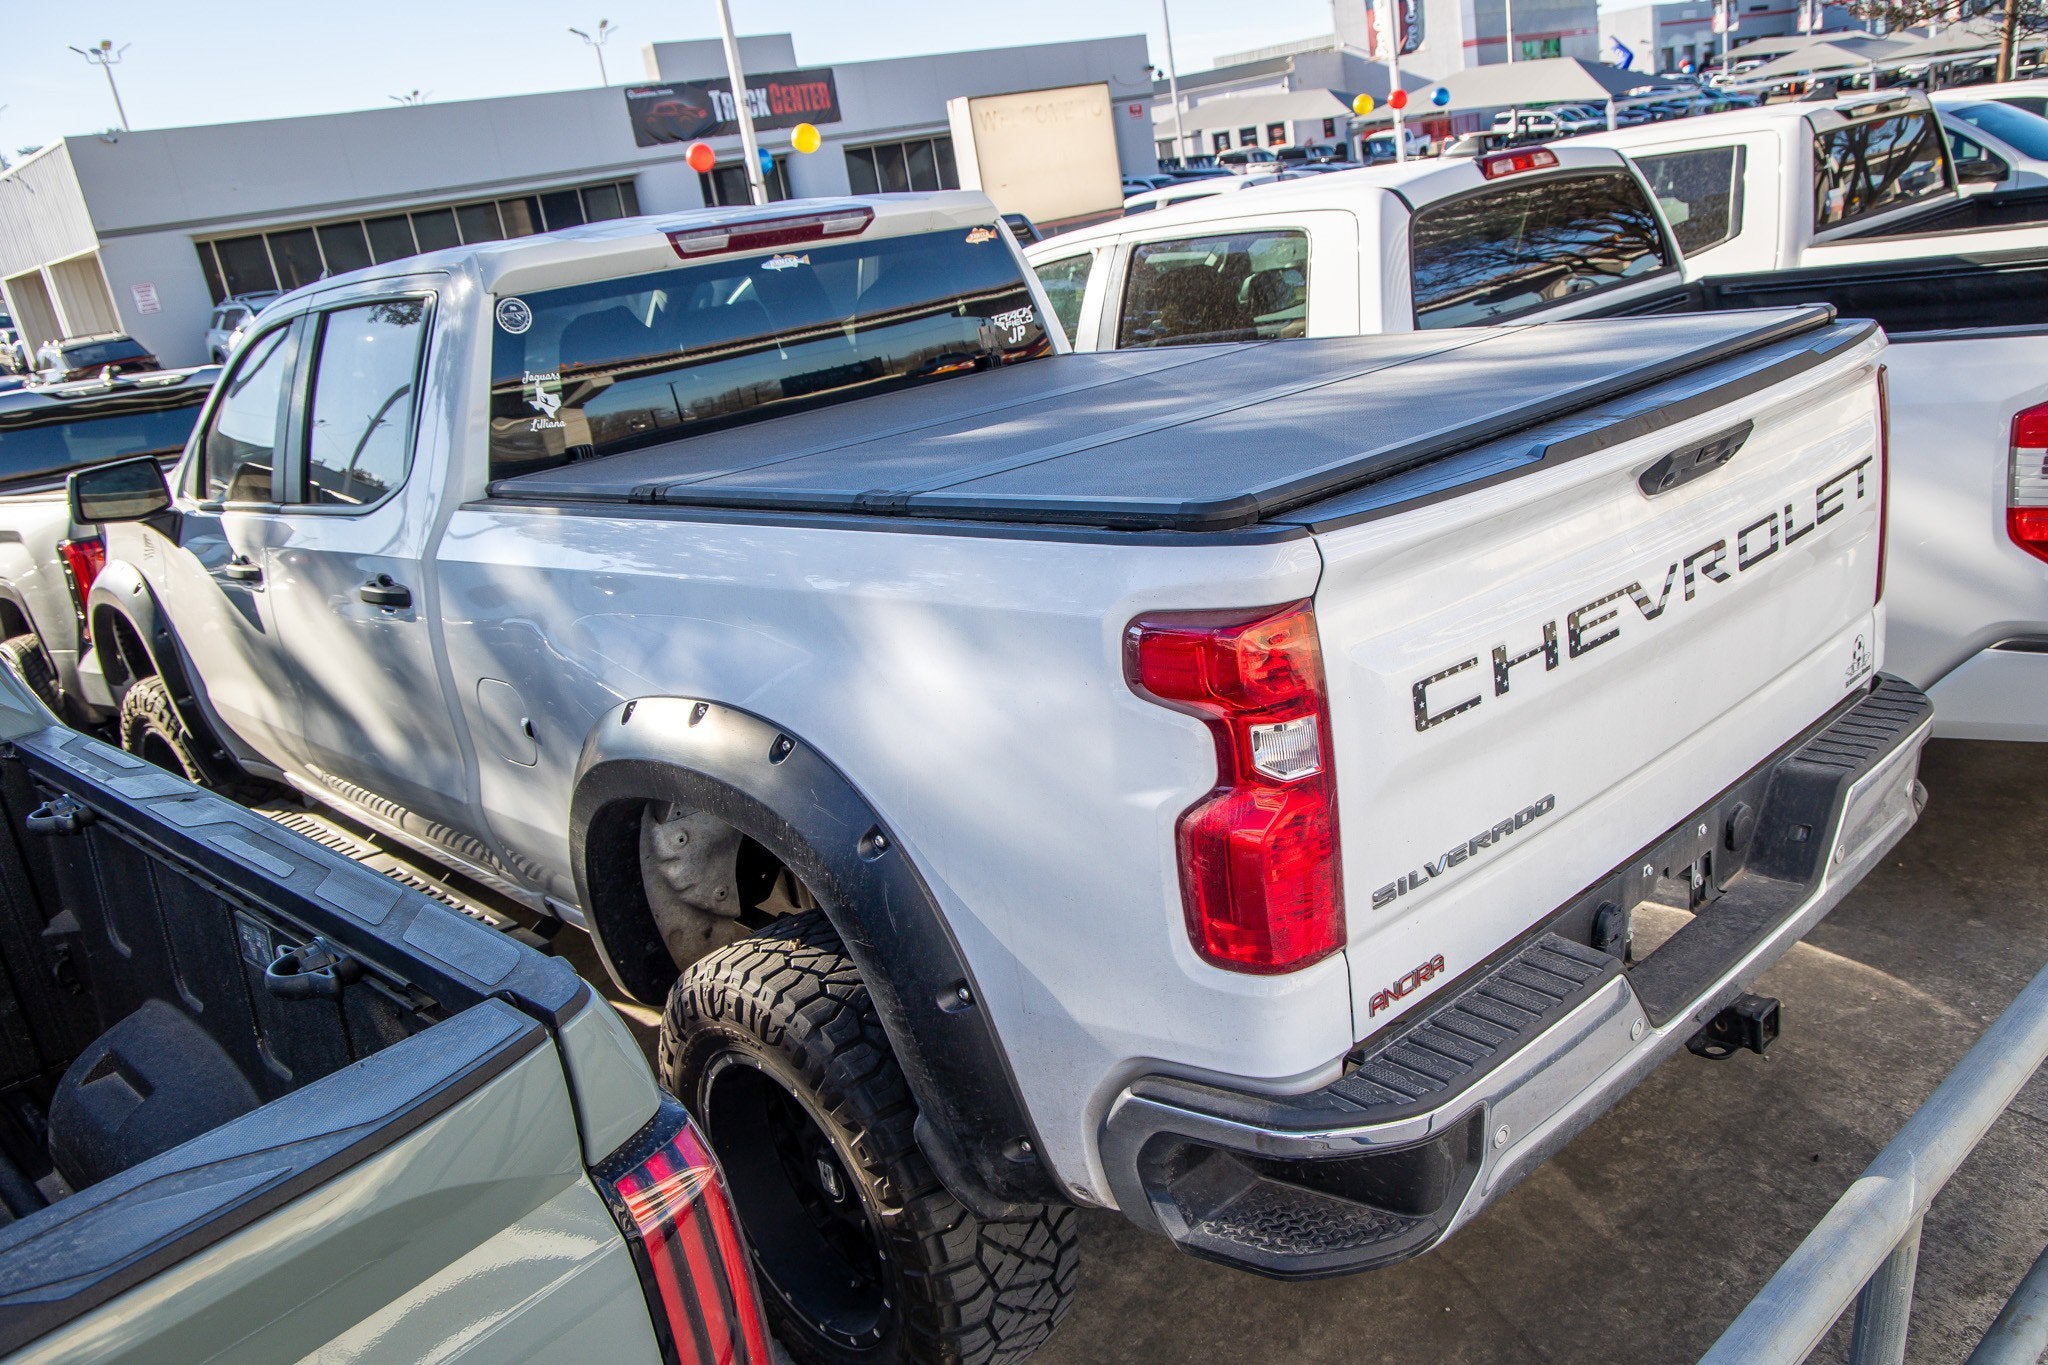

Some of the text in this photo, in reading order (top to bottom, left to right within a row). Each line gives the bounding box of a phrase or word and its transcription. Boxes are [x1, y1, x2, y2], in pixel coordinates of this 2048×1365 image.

[708, 82, 831, 122] TRCK CENTER
[991, 305, 1032, 324] TRACK
[1008, 325, 1026, 344] JP
[522, 370, 560, 387] Jaguars
[530, 419, 566, 431] Lilliana
[1412, 455, 1873, 733] CHEVROLET
[1372, 793, 1556, 911] SILVERADO
[1369, 953, 1445, 1018] ANCIRA
